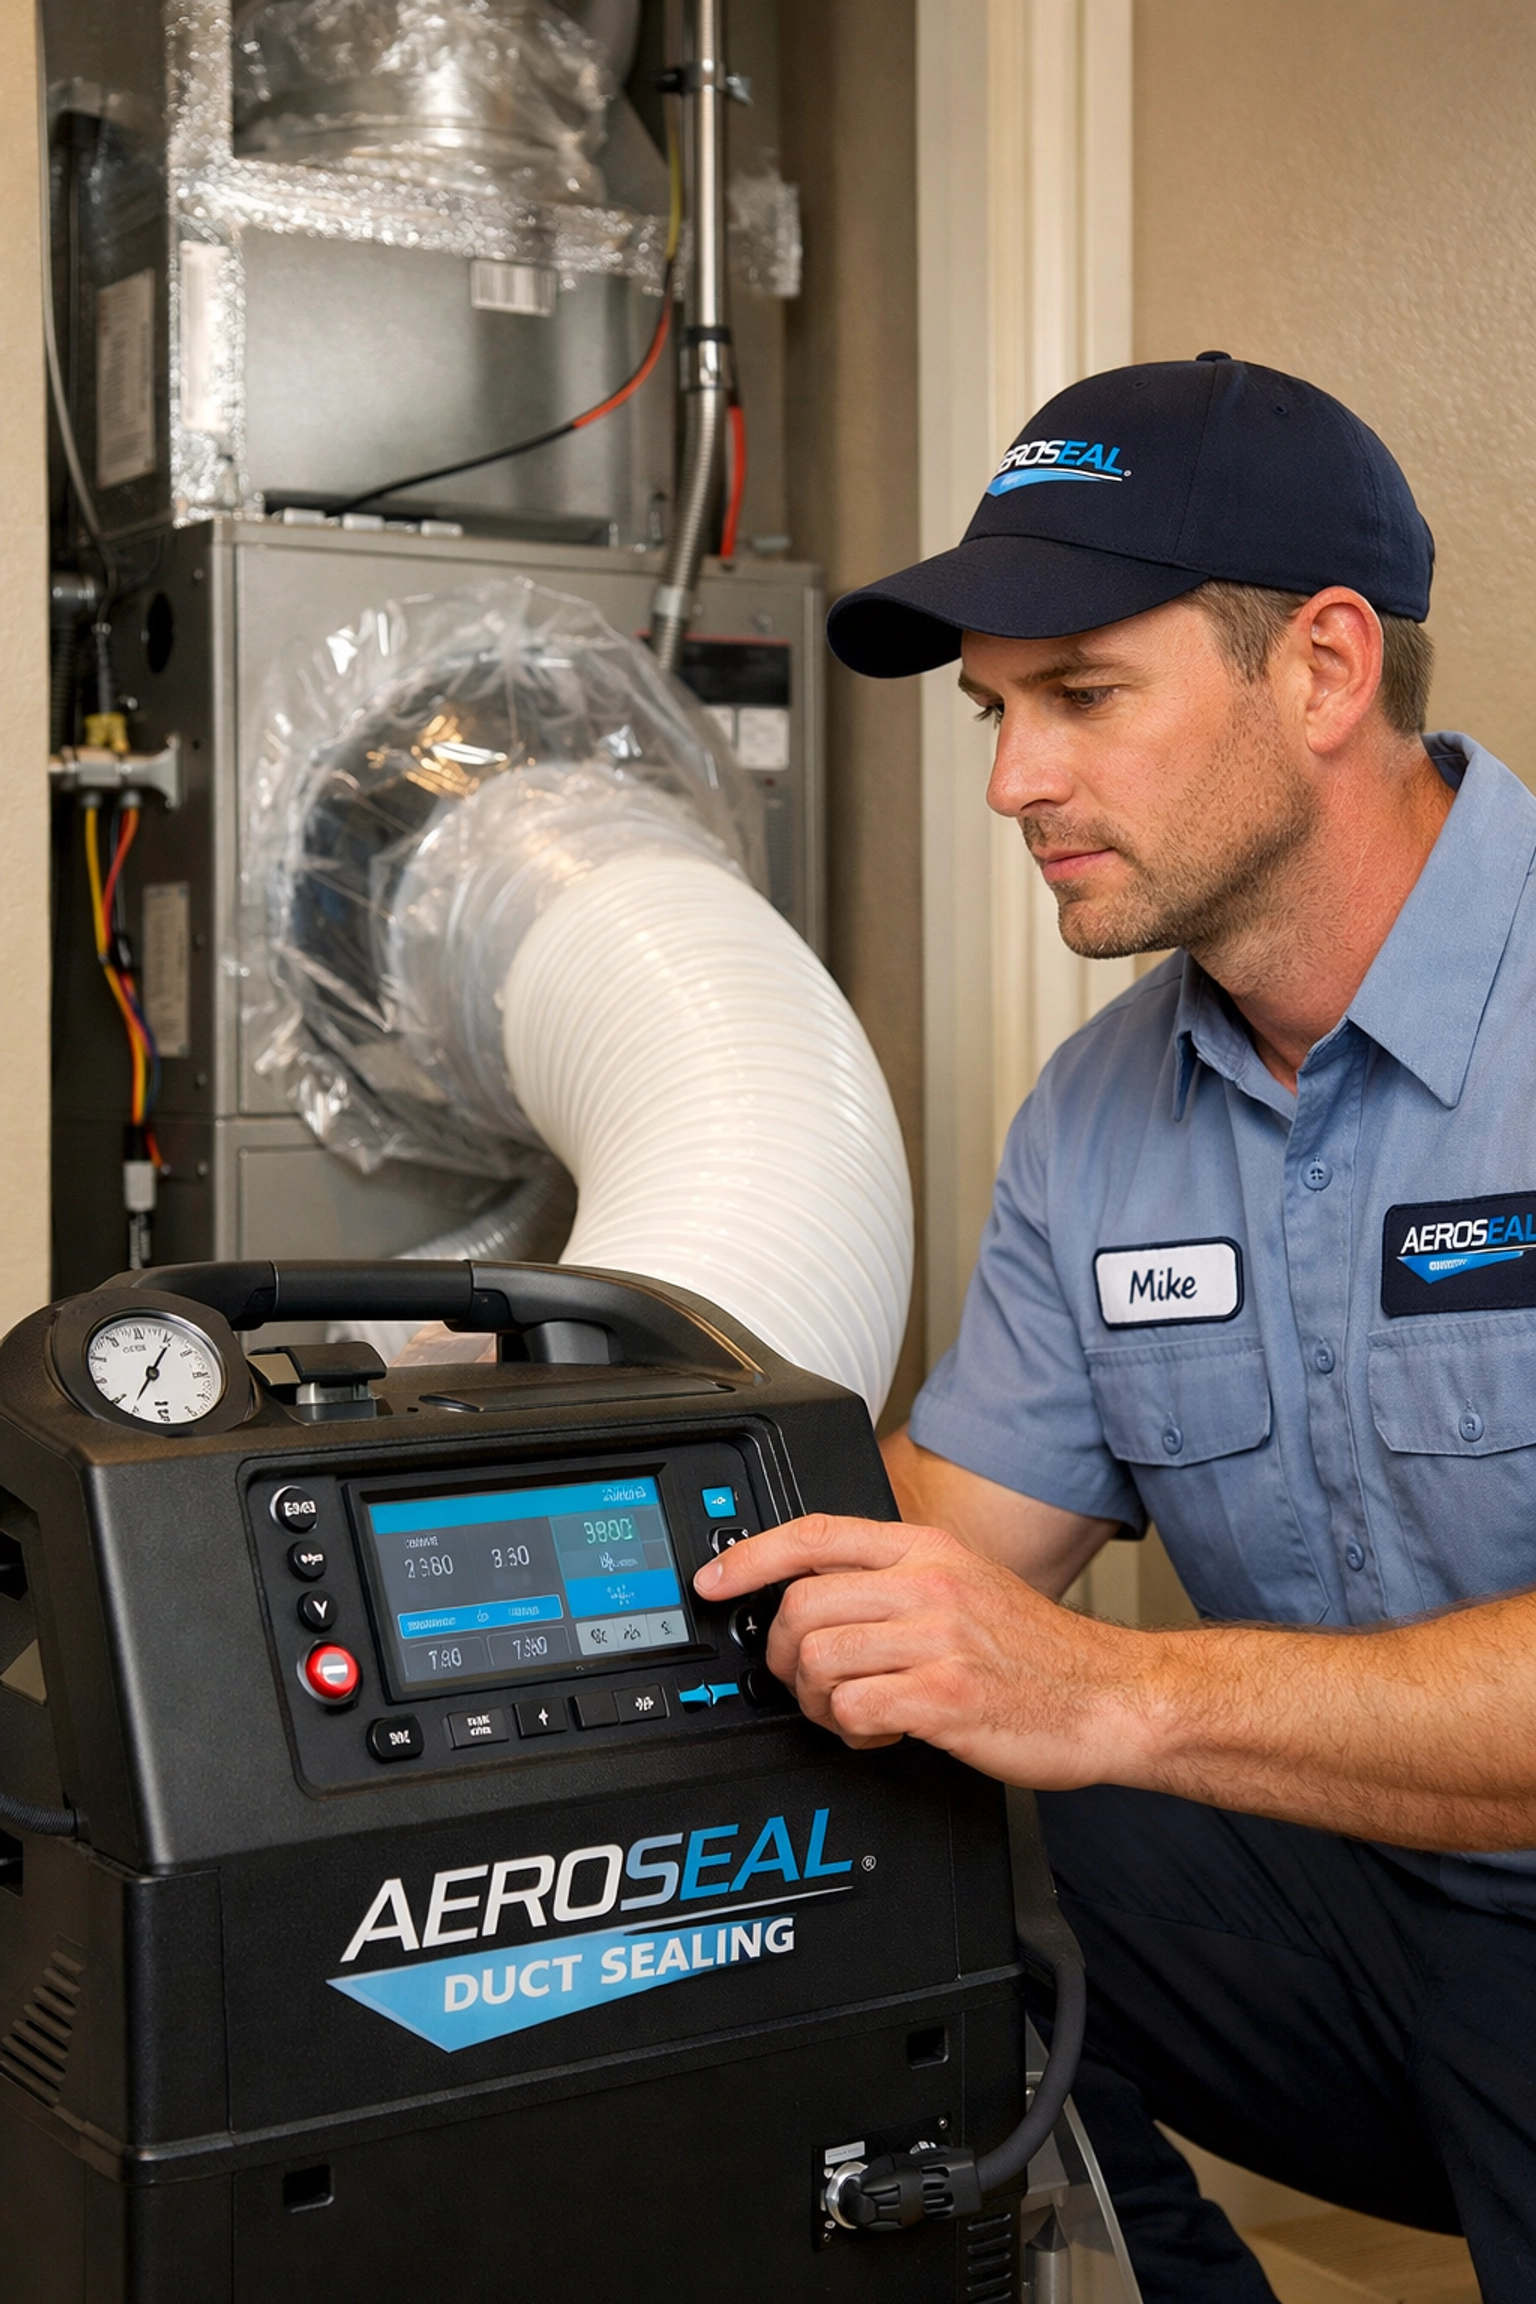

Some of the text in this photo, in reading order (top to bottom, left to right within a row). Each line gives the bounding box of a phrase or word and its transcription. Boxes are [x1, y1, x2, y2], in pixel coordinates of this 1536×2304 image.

[997, 440, 1123, 475] EROSEAL
[1400, 1213, 1536, 1254] AEROSEAL
[1129, 1267, 1197, 1304] Mike
[340, 1808, 854, 1963] AEROSEAL
[444, 1917, 796, 2013] DUCT SEALING
